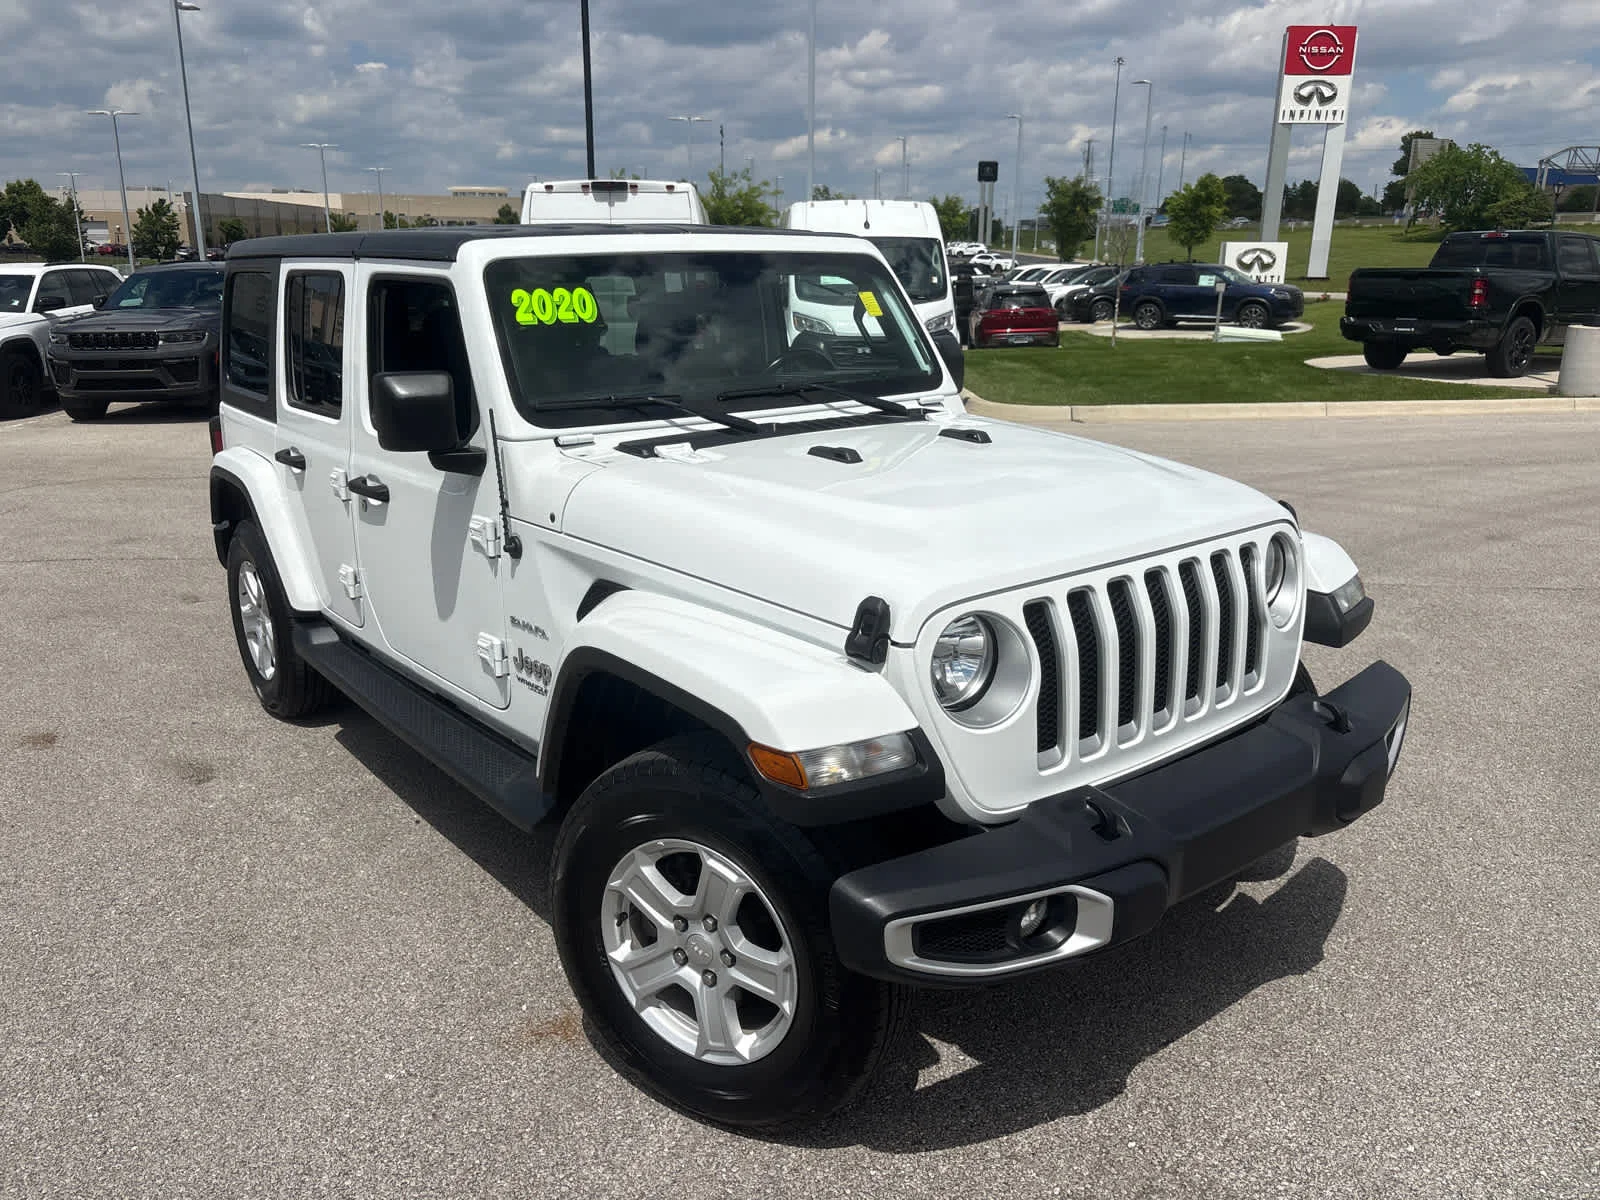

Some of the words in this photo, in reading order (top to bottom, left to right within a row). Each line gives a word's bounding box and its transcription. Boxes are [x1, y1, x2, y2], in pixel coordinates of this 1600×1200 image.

[1281, 109, 1345, 121] INFINITI
[511, 287, 598, 325] 2020
[513, 648, 552, 687] Jeep
